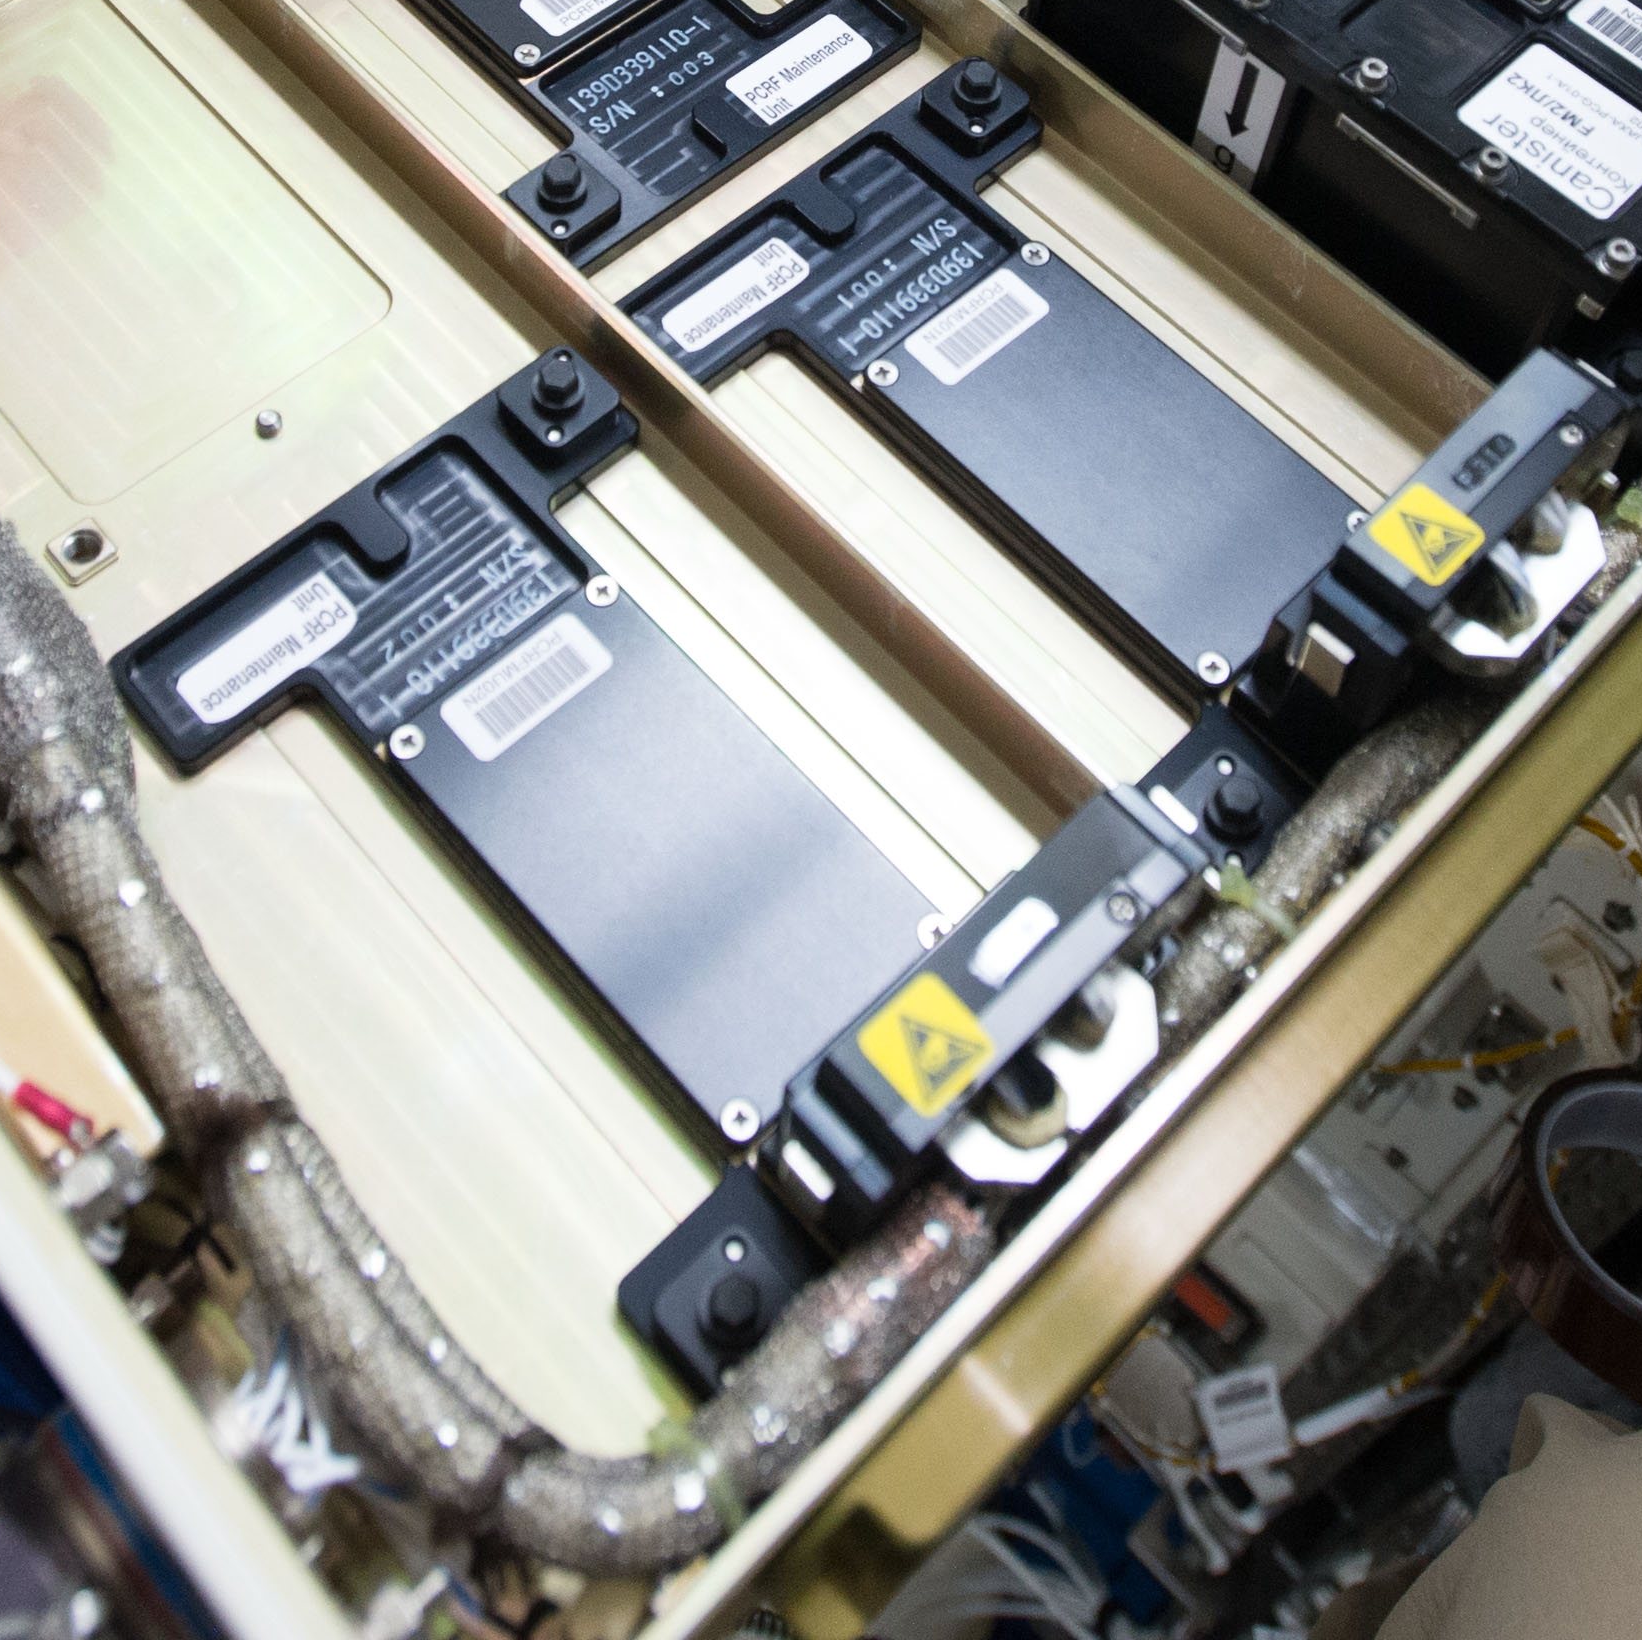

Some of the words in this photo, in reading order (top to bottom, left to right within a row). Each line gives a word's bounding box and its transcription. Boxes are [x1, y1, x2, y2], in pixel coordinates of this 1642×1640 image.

[567, 15, 711, 114] 139D339110-1
[588, 99, 637, 134] S/N
[668, 50, 715, 86] 003
[745, 75, 782, 105] PCRF
[778, 31, 854, 83] Maintenance
[761, 95, 794, 120] Unit
[1483, 113, 1614, 211] Canister
[1530, 116, 1634, 194] Контейнер
[753, 241, 786, 268] Unit
[910, 218, 958, 256] S/N
[767, 258, 804, 293] PCRF
[837, 270, 883, 310] 001
[837, 240, 984, 357] 139D339110-1
[683, 282, 768, 345] Maintenance
[478, 542, 531, 590] S/N
[291, 581, 330, 612] Unit
[302, 601, 349, 644] PCRF
[200, 632, 304, 713] Maintenance
